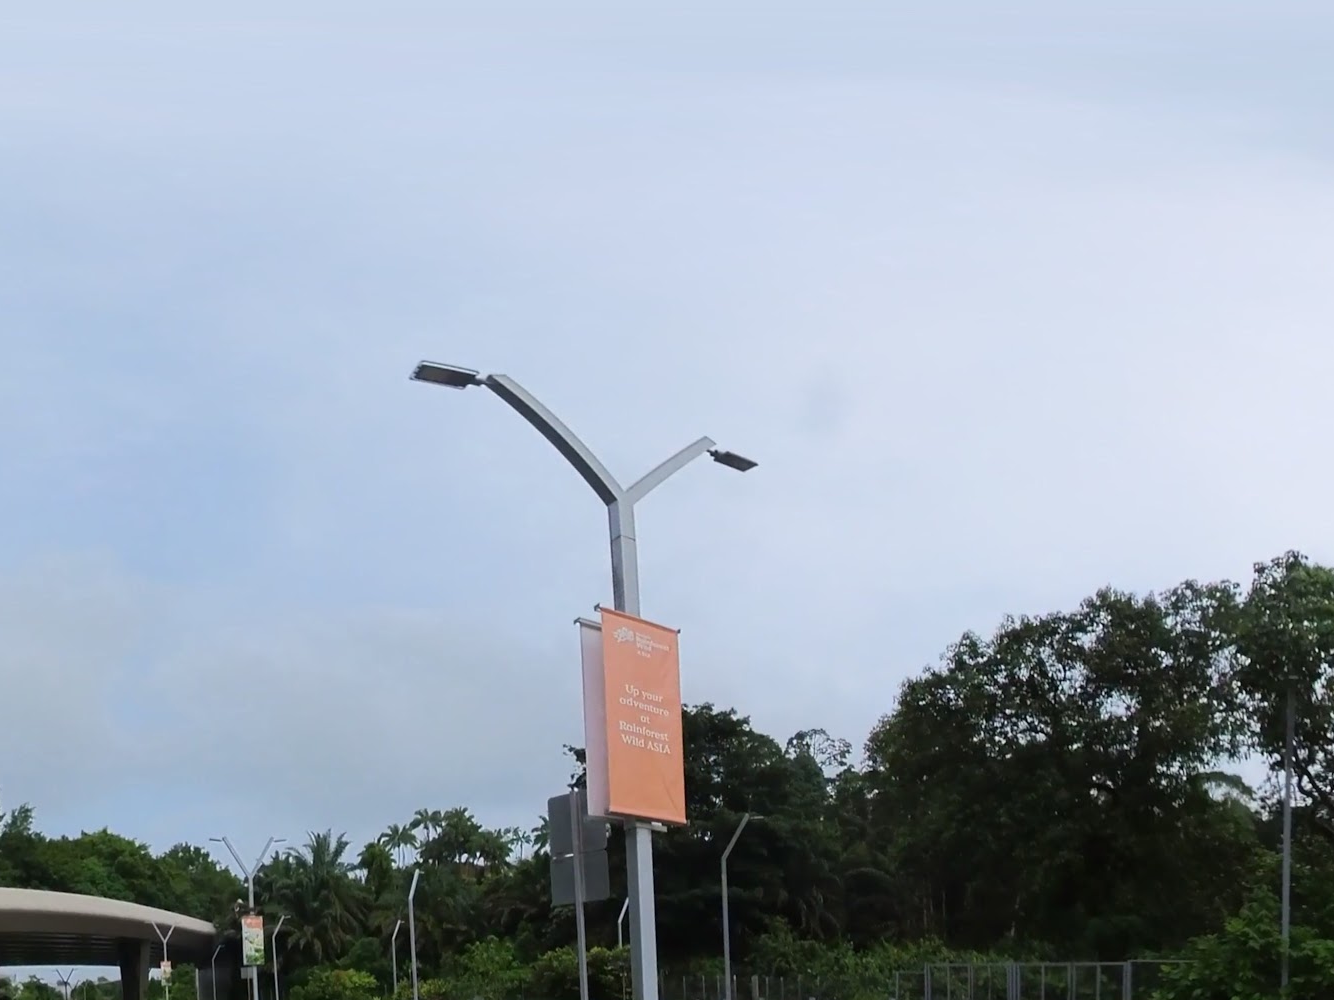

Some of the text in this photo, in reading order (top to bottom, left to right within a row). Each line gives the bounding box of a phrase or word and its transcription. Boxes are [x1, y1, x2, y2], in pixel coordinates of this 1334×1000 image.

[625, 684, 663, 704] Up your
[619, 697, 670, 717] adventure
[640, 715, 650, 724] at
[619, 721, 669, 742] Rainforest
[621, 734, 671, 754] Wild ASIA
